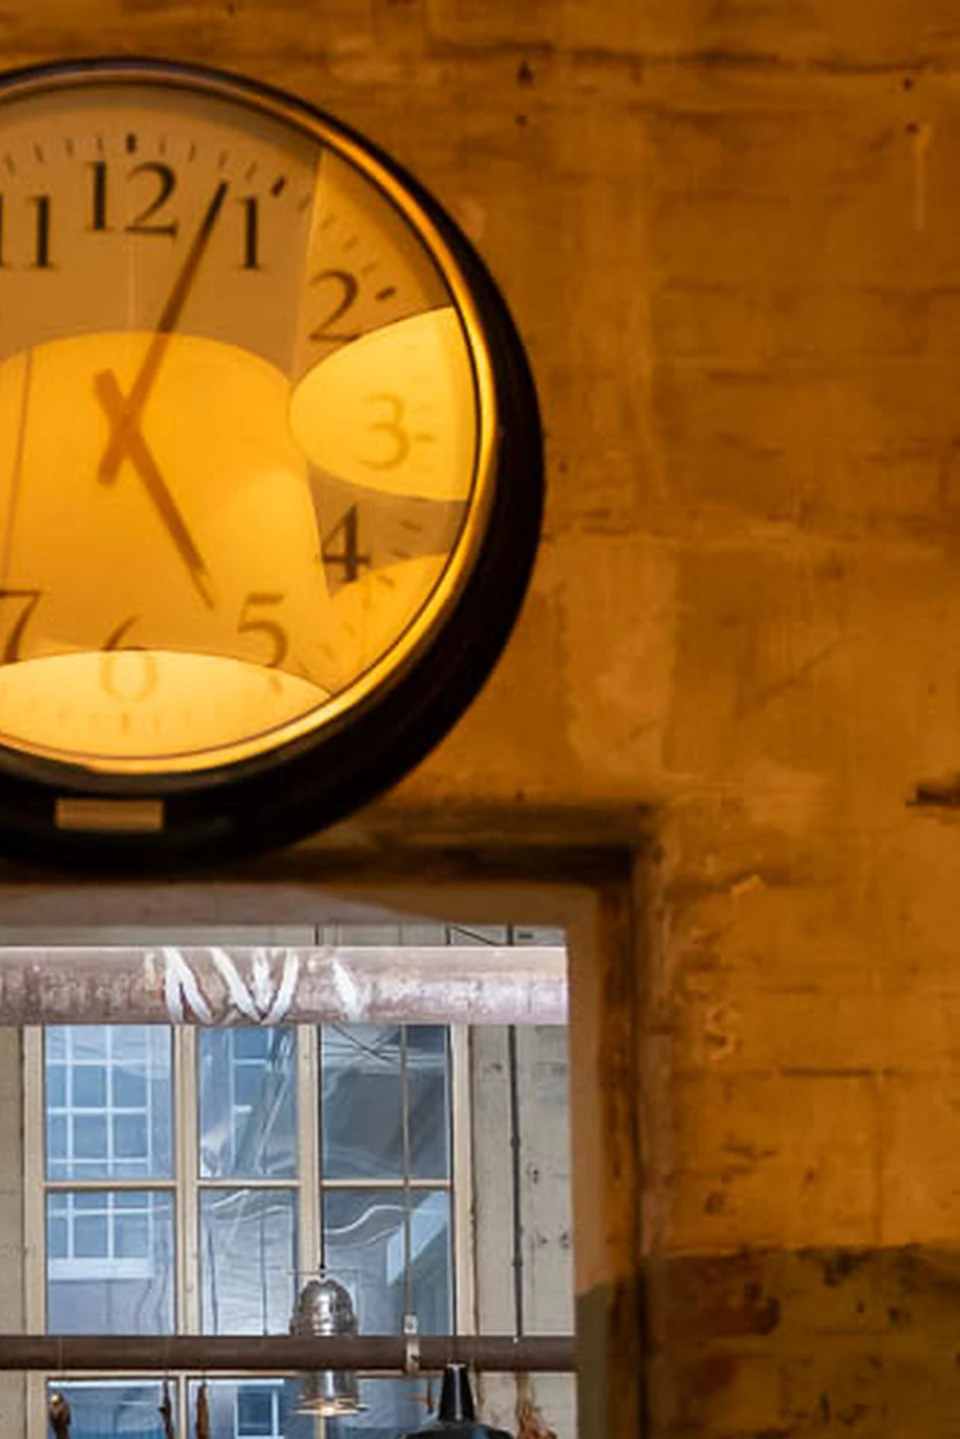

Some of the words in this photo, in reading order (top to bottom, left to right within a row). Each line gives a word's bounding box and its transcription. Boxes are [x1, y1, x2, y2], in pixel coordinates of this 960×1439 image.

[85, 160, 178, 237] 12
[233, 195, 267, 271] 1
[308, 270, 361, 344] 2
[357, 392, 409, 472] 3
[320, 506, 371, 584] 4
[99, 614, 157, 703] 6
[237, 592, 288, 669] 5
